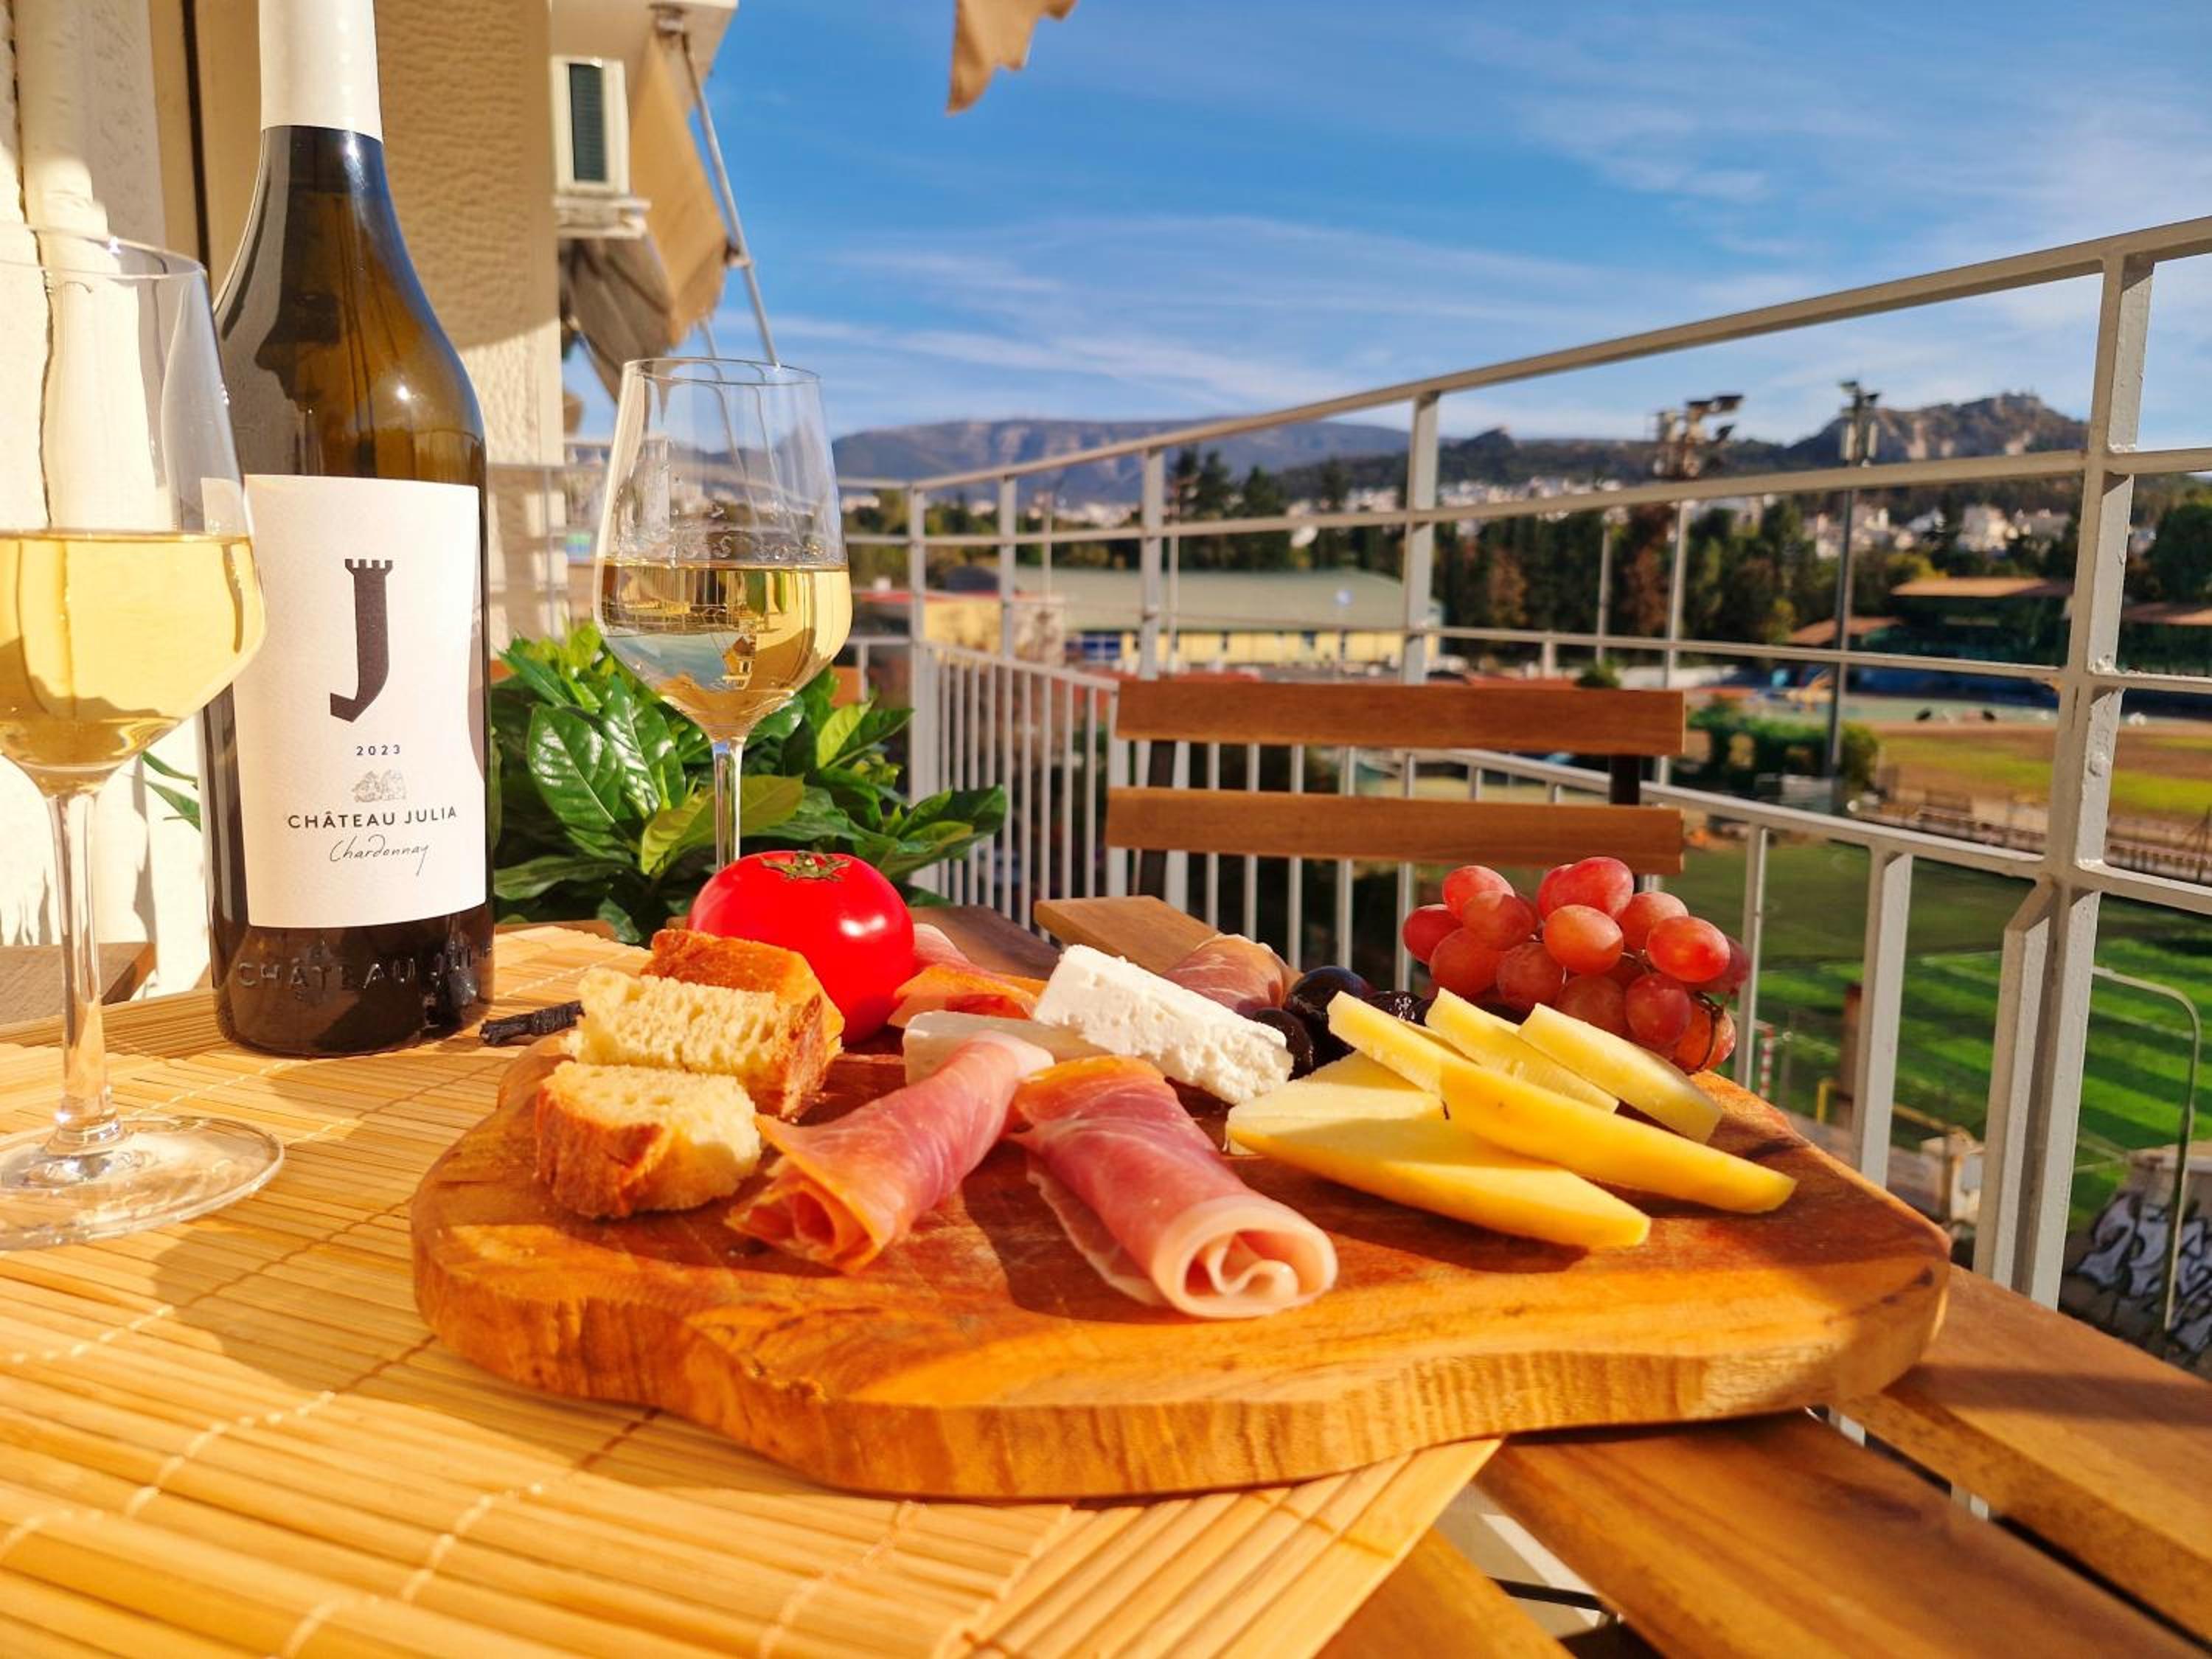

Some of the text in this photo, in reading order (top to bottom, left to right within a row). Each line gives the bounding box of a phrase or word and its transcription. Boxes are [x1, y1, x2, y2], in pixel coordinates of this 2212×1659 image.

[356, 744, 400, 757] 2023
[288, 806, 457, 829] CHÂTEAU JULIA
[330, 833, 429, 876] Chardonnay
